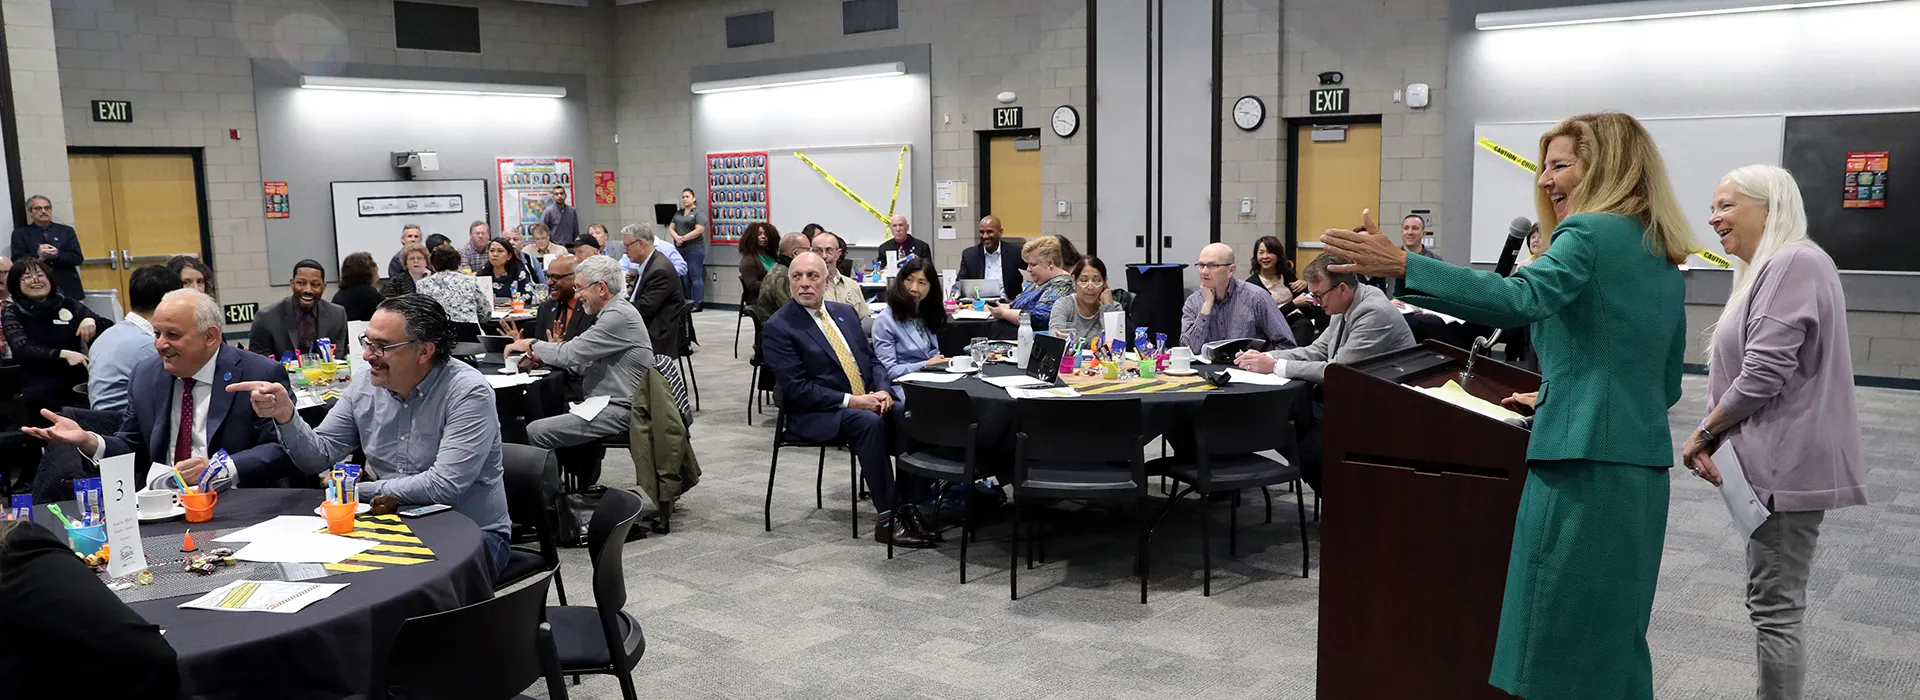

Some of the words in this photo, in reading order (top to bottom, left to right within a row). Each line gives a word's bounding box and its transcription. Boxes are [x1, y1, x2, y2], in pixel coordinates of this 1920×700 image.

[1315, 90, 1344, 111] EXIT
[98, 101, 127, 120] EXIT
[997, 108, 1018, 127] EXIT
[1493, 145, 1517, 162] CAUTION
[1703, 251, 1731, 269] CAUTION
[230, 304, 255, 322] EXIT
[116, 479, 124, 502] 3
